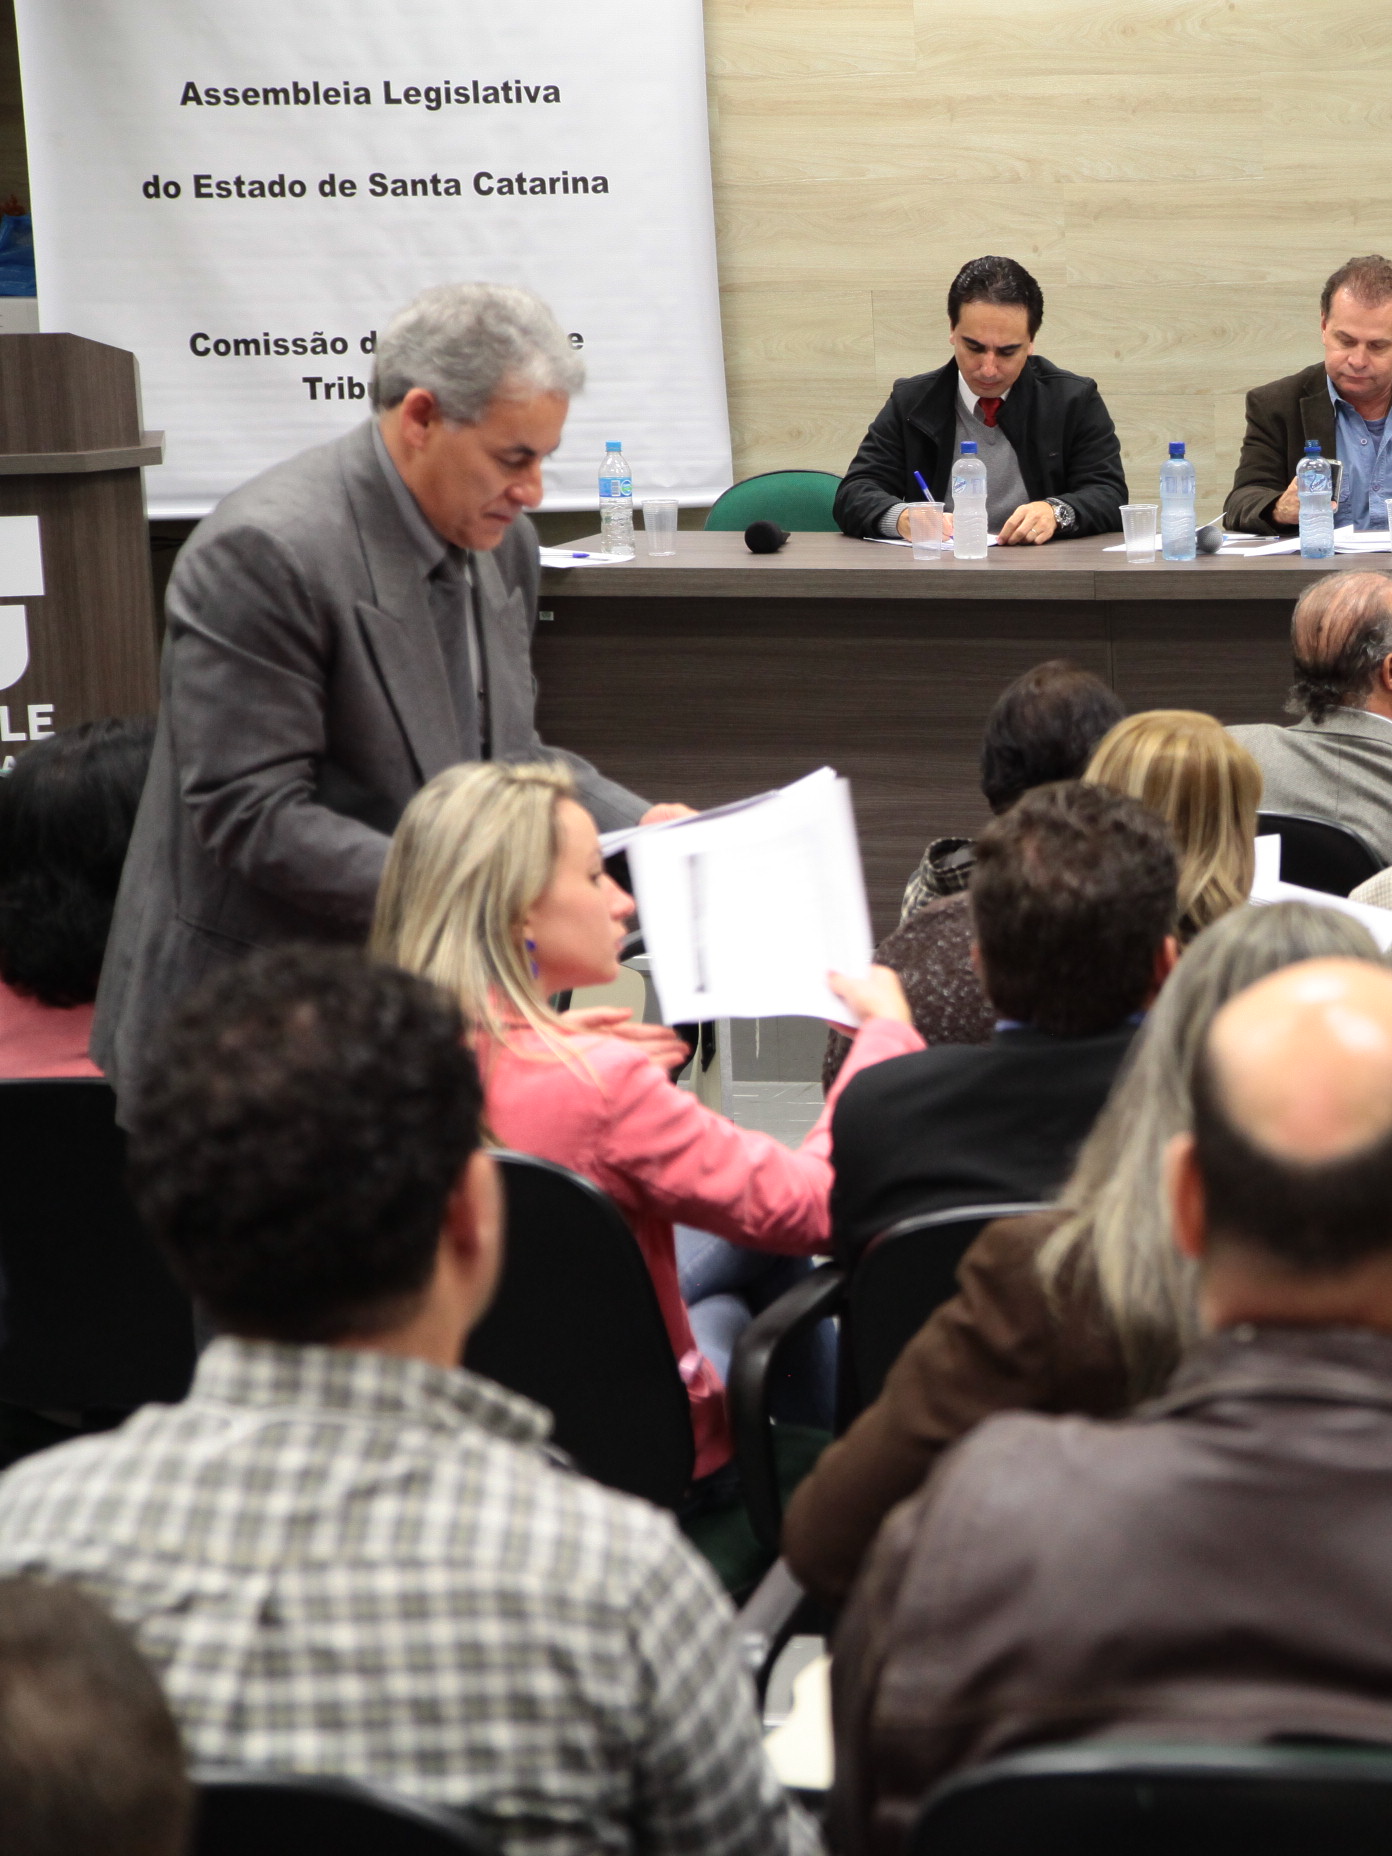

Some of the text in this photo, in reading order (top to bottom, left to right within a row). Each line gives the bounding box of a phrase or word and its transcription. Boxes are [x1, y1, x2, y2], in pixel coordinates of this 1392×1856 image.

[180, 79, 561, 111] Assembleia Legislativa
[142, 170, 609, 200] do Estado de Santa Catarina
[189, 330, 348, 358] Comissão
[360, 330, 378, 355] d
[303, 376, 372, 400] Trib
